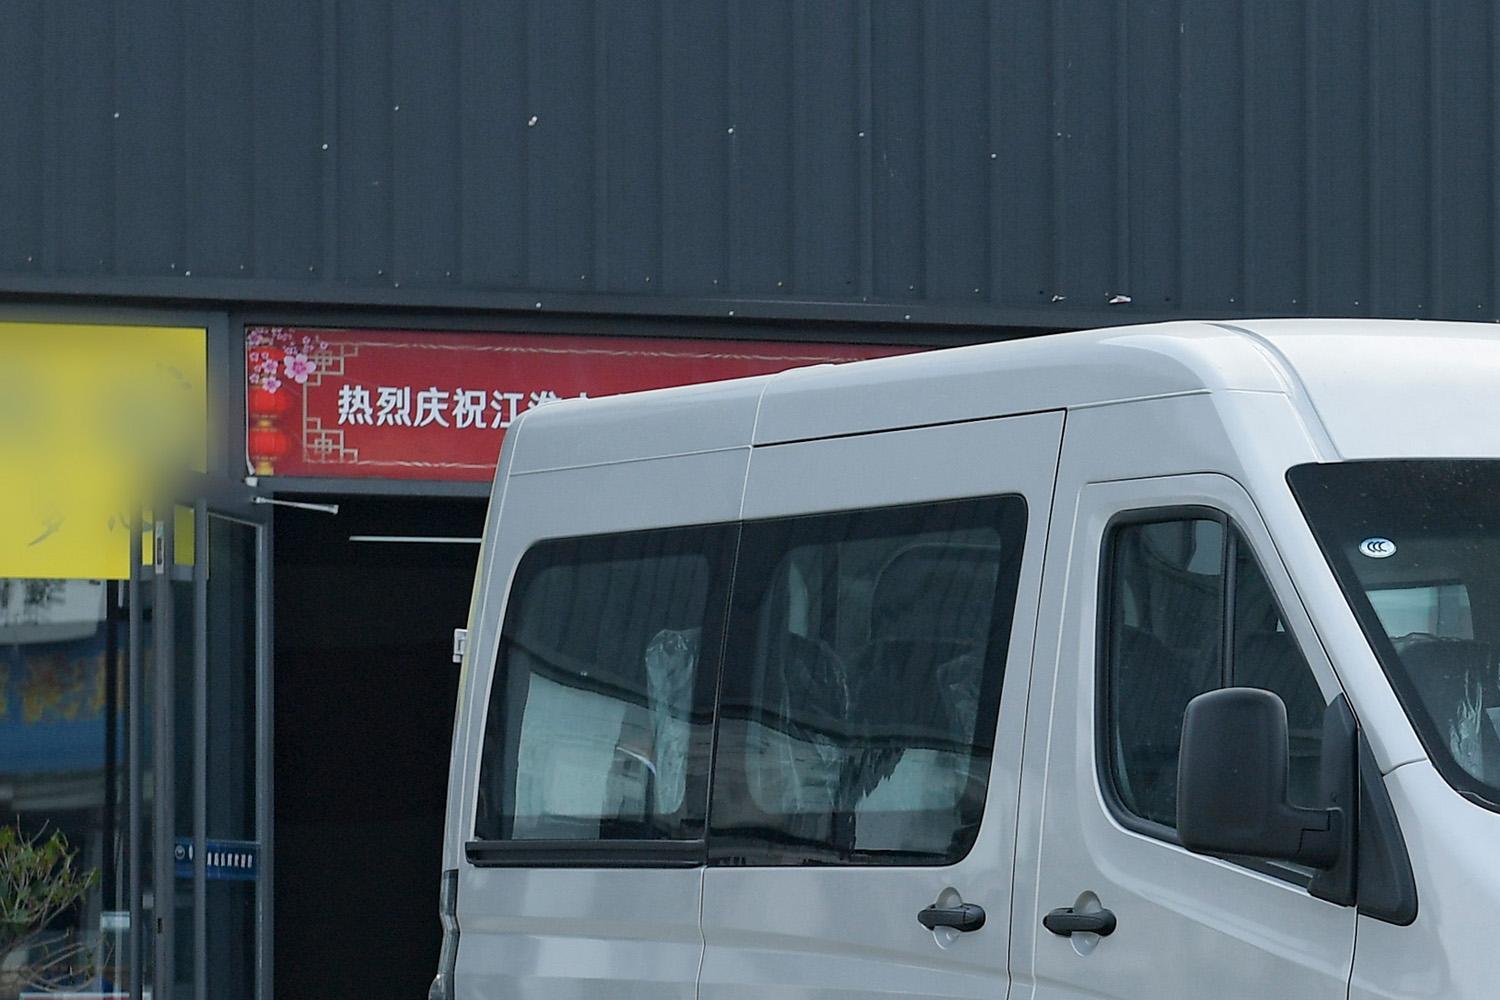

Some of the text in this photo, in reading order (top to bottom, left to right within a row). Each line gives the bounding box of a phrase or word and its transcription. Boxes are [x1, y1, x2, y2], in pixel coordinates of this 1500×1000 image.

[337, 384, 589, 429] 热烈庆祝江
